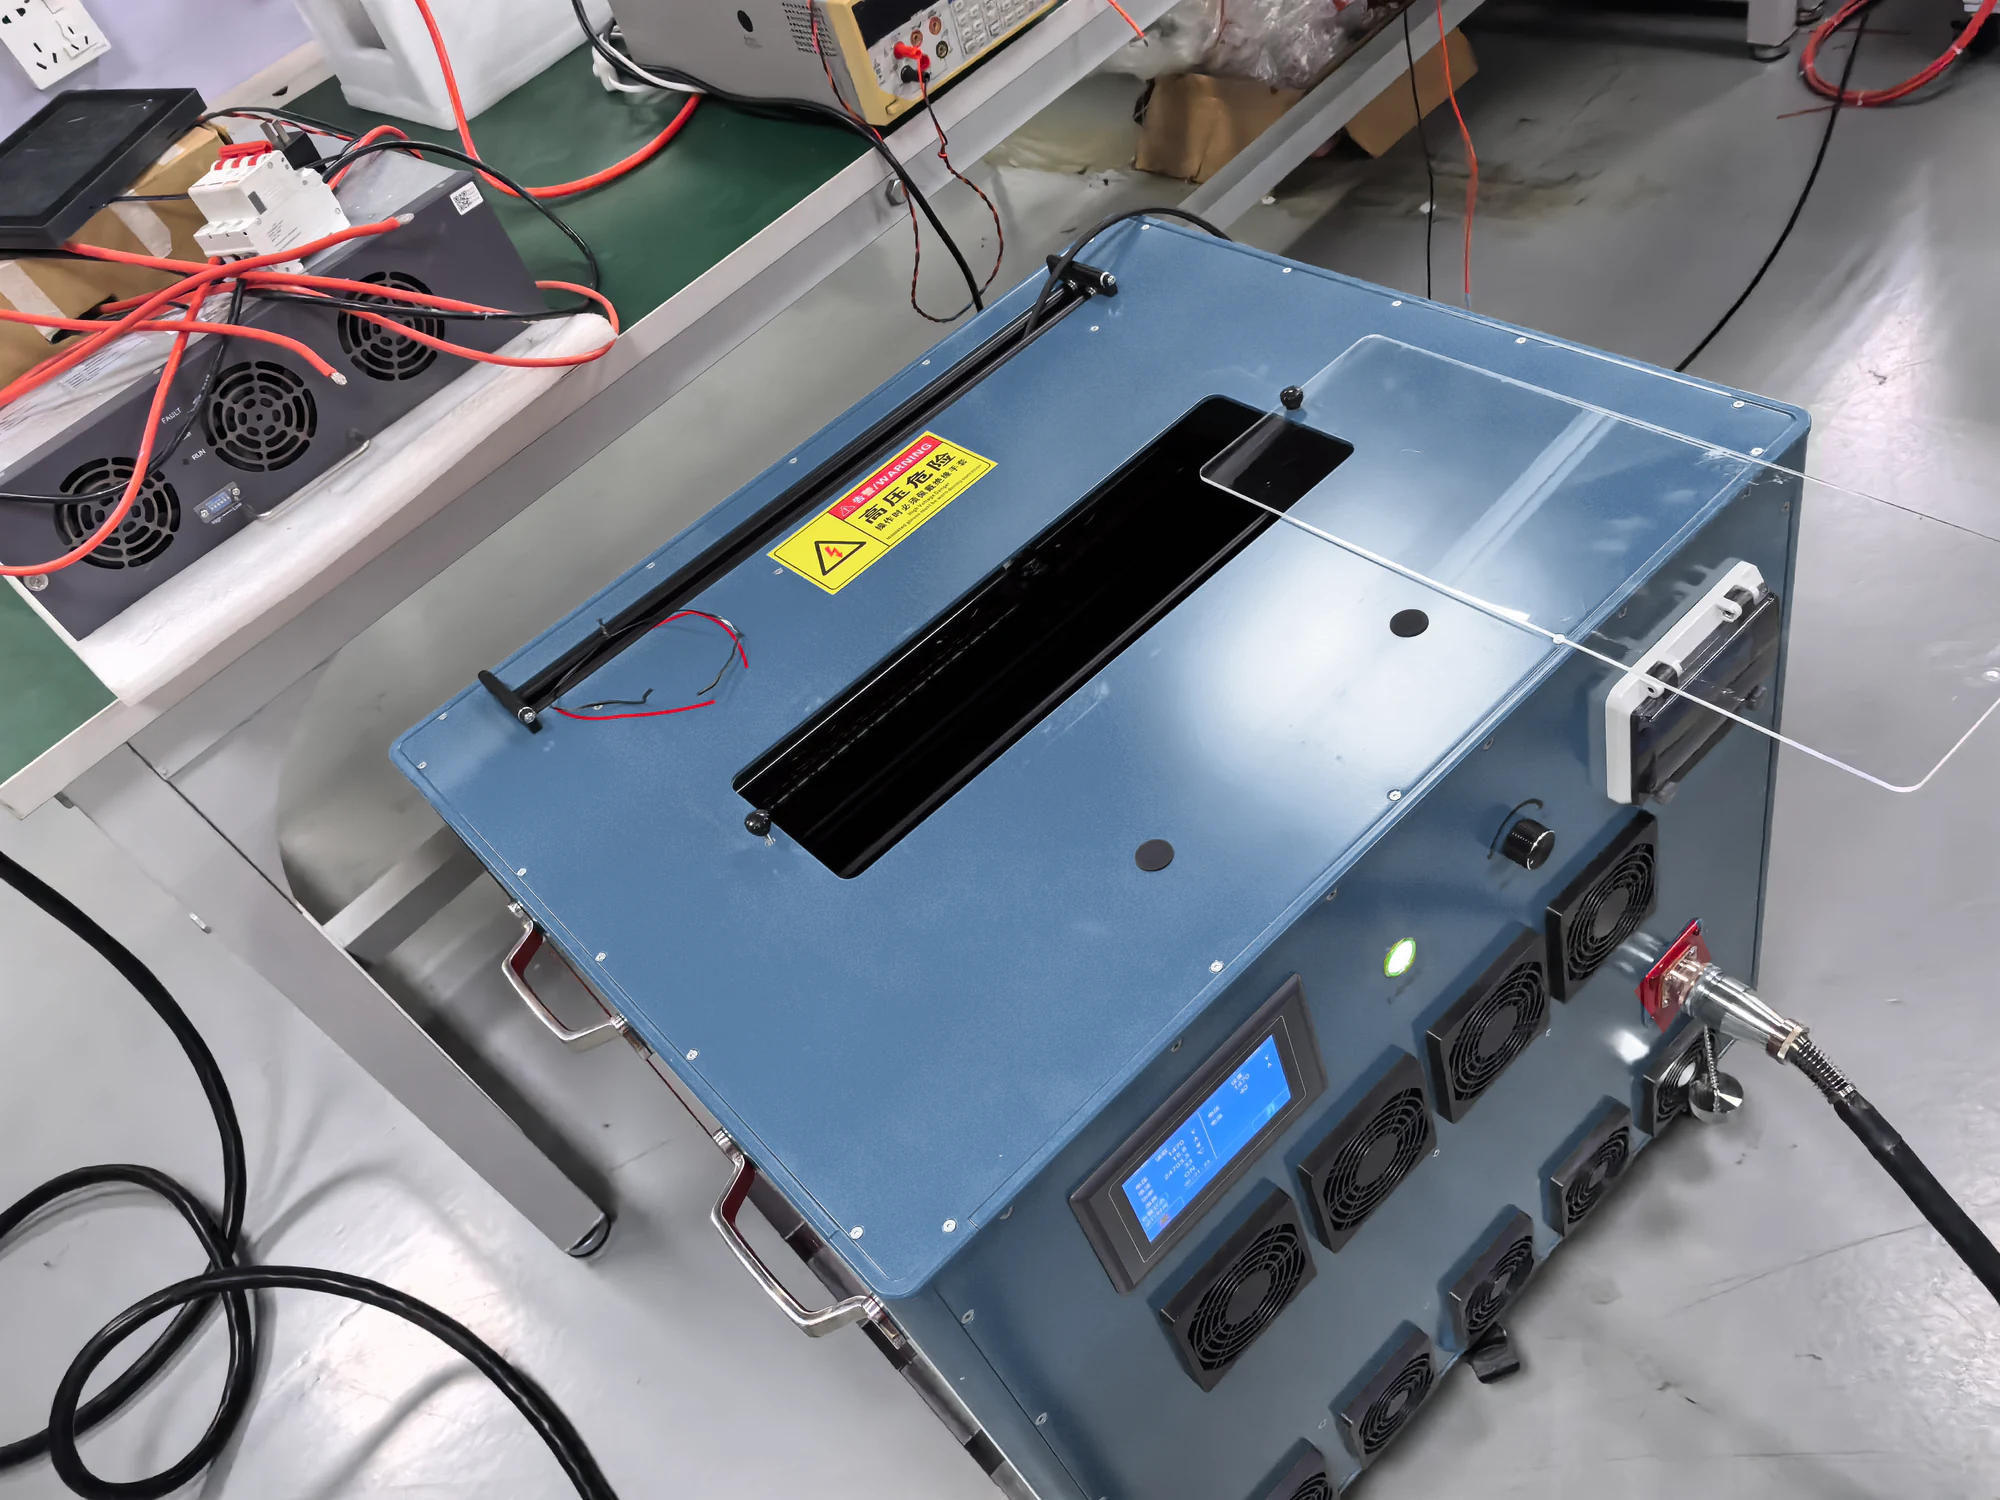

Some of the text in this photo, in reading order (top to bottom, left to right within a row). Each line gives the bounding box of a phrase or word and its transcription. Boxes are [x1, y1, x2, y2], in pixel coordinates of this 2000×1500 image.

[161, 407, 182, 424] FAULT
[191, 448, 206, 461] RUN
[856, 450, 956, 525] 高压危险
[874, 457, 968, 531] 操作时必须佩戴绝缘手套
[1234, 1072, 1249, 1091] 1470
[1239, 1084, 1248, 1095] 40
[1168, 1138, 1184, 1157] 1470
[1184, 1164, 1195, 1178] ON
